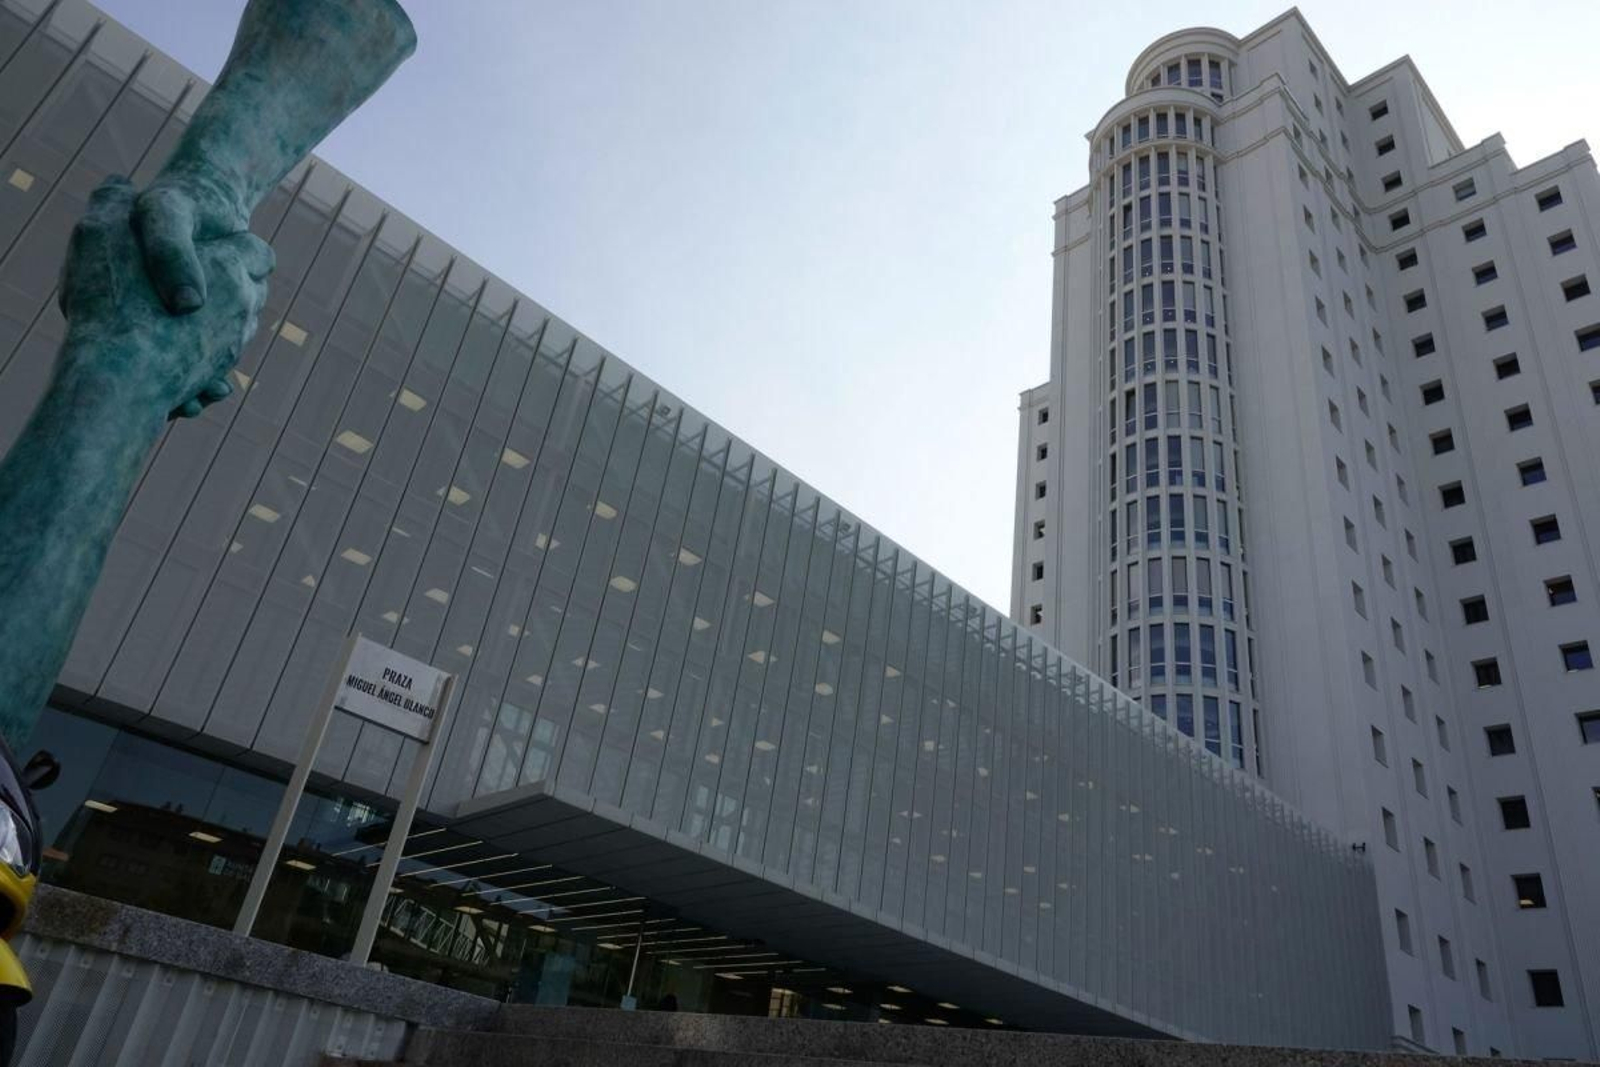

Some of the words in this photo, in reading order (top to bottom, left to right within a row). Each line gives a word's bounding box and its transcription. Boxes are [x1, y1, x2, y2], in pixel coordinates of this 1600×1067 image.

[382, 667, 413, 690] PRAZA
[346, 674, 377, 697] MIGUEL
[377, 685, 402, 707] ÁNGEL
[403, 698, 435, 719] BLANCO
